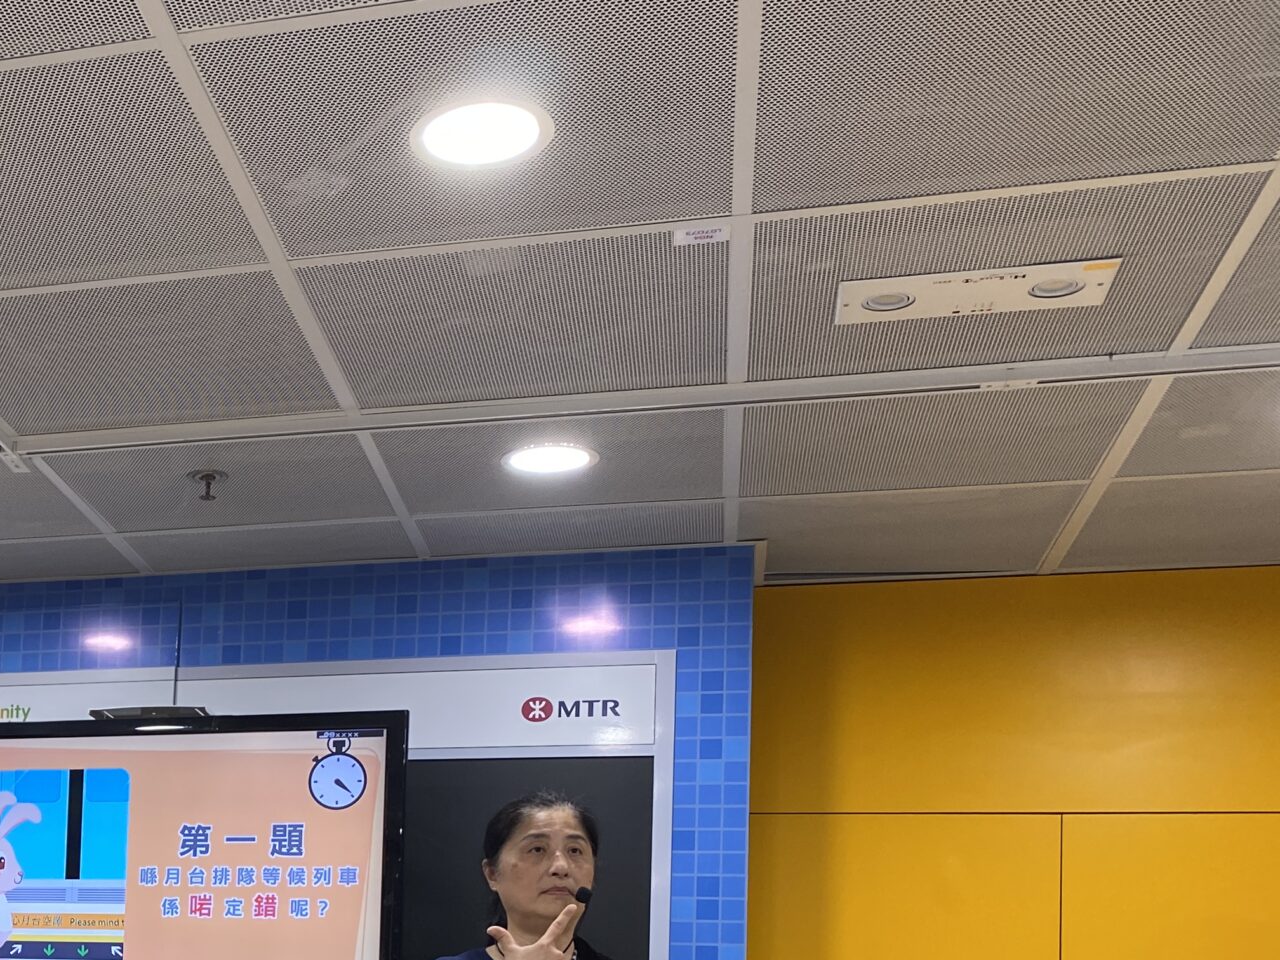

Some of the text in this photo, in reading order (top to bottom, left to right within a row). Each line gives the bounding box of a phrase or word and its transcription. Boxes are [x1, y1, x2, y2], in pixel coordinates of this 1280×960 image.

[557, 699, 621, 718] MTR
[178, 824, 305, 858] 第一題
[139, 866, 359, 887] 喺月台排隊等候列車
[70, 917, 96, 927] Please
[97, 918, 120, 927] mind
